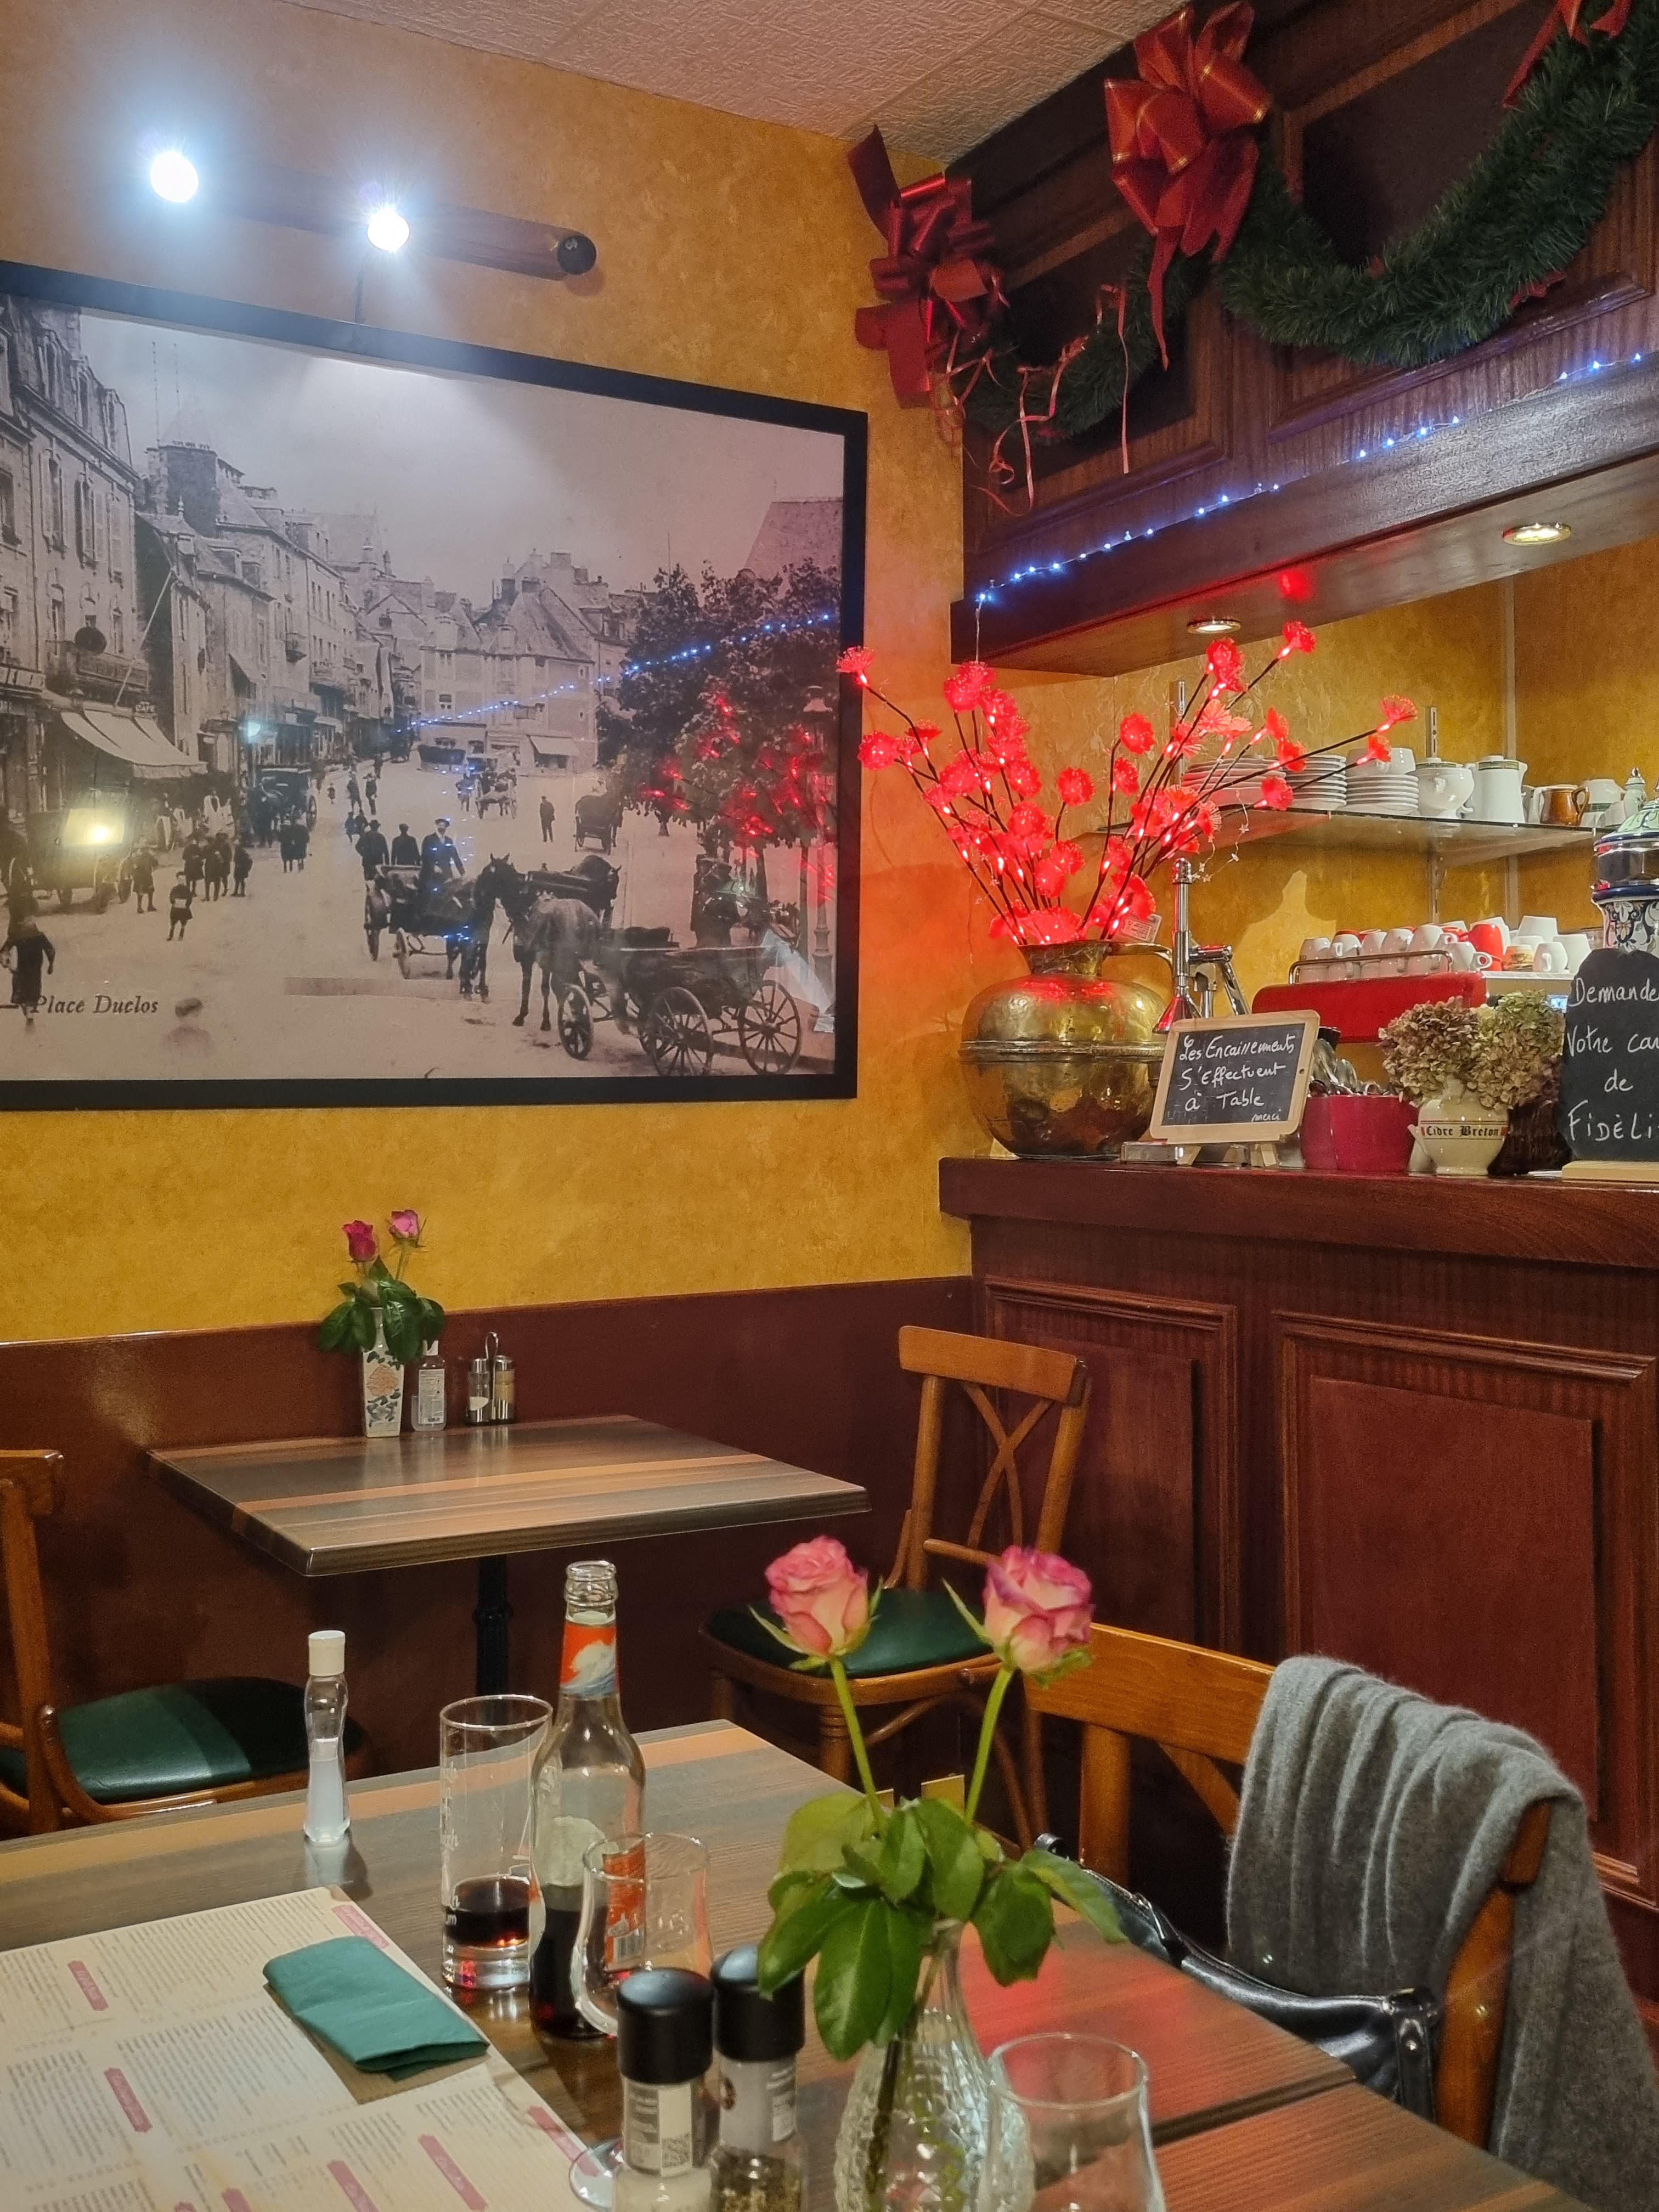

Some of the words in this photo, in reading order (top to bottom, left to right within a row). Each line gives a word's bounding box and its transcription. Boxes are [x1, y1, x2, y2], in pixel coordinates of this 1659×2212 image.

[30, 995, 85, 1014] Place
[93, 994, 159, 1014] Duclos
[1179, 1035, 1202, 1061] Les
[1567, 1025, 1613, 1057] Votre
[1604, 1068, 1634, 1092] de
[1185, 1092, 1203, 1111] à
[1216, 1087, 1264, 1109] Table
[1426, 1126, 1454, 1136] Cidre
[1460, 1125, 1499, 1137] Breton
